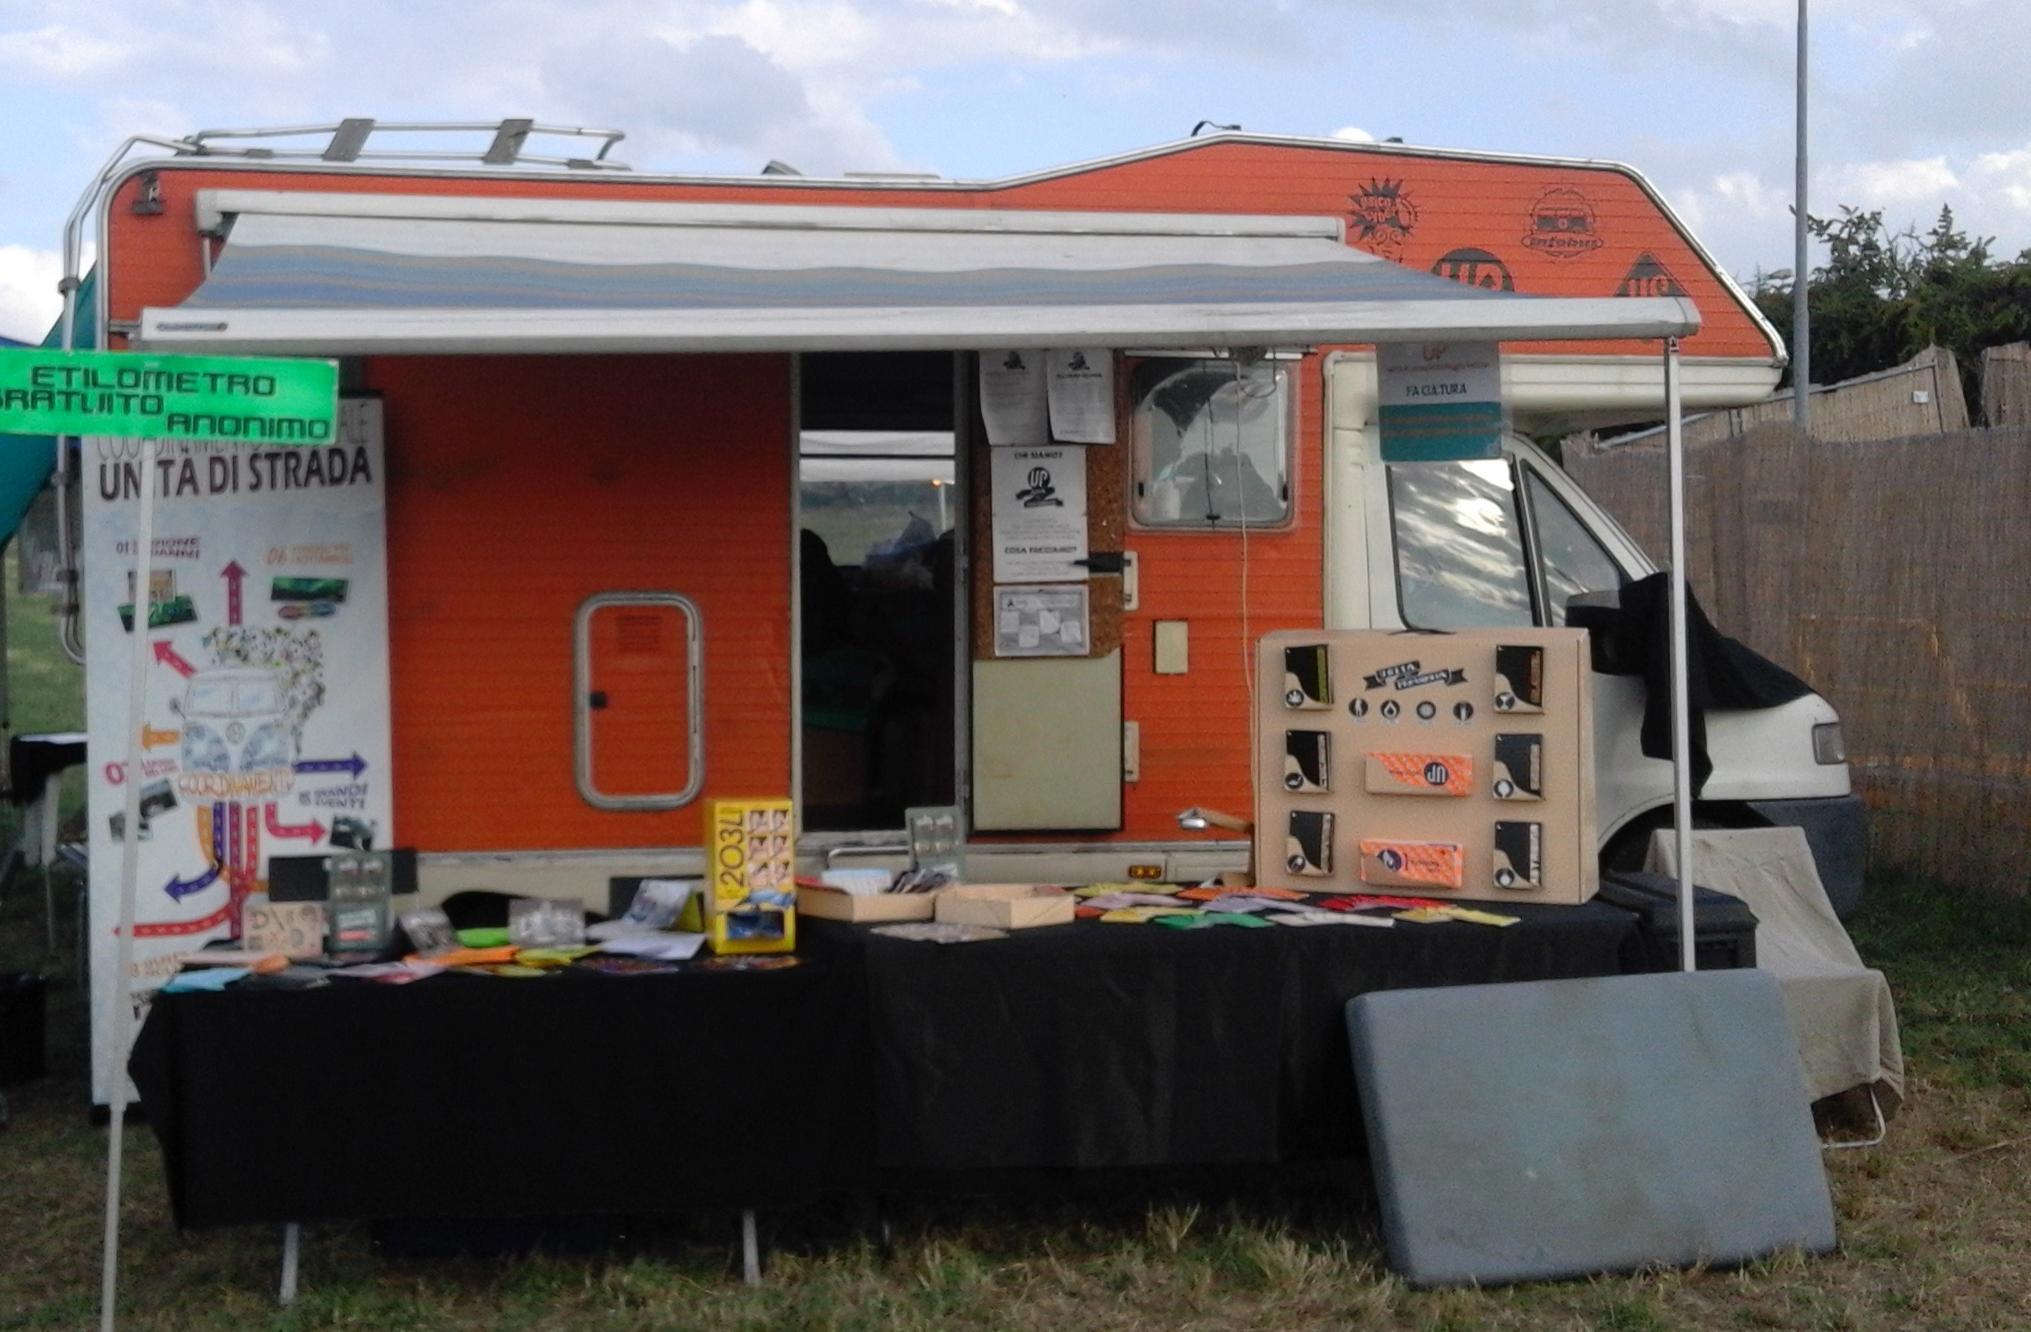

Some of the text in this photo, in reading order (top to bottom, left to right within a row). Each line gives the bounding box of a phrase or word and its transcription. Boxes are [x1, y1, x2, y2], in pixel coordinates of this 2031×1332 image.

[31, 366, 276, 397] ETILOMETRO
[0, 388, 164, 416] RATUITO
[167, 412, 330, 440] ANONIMO
[100, 446, 200, 501] UNTÀ
[209, 454, 239, 495] DI
[249, 446, 373, 492] STRADA
[1030, 469, 1049, 488] UP
